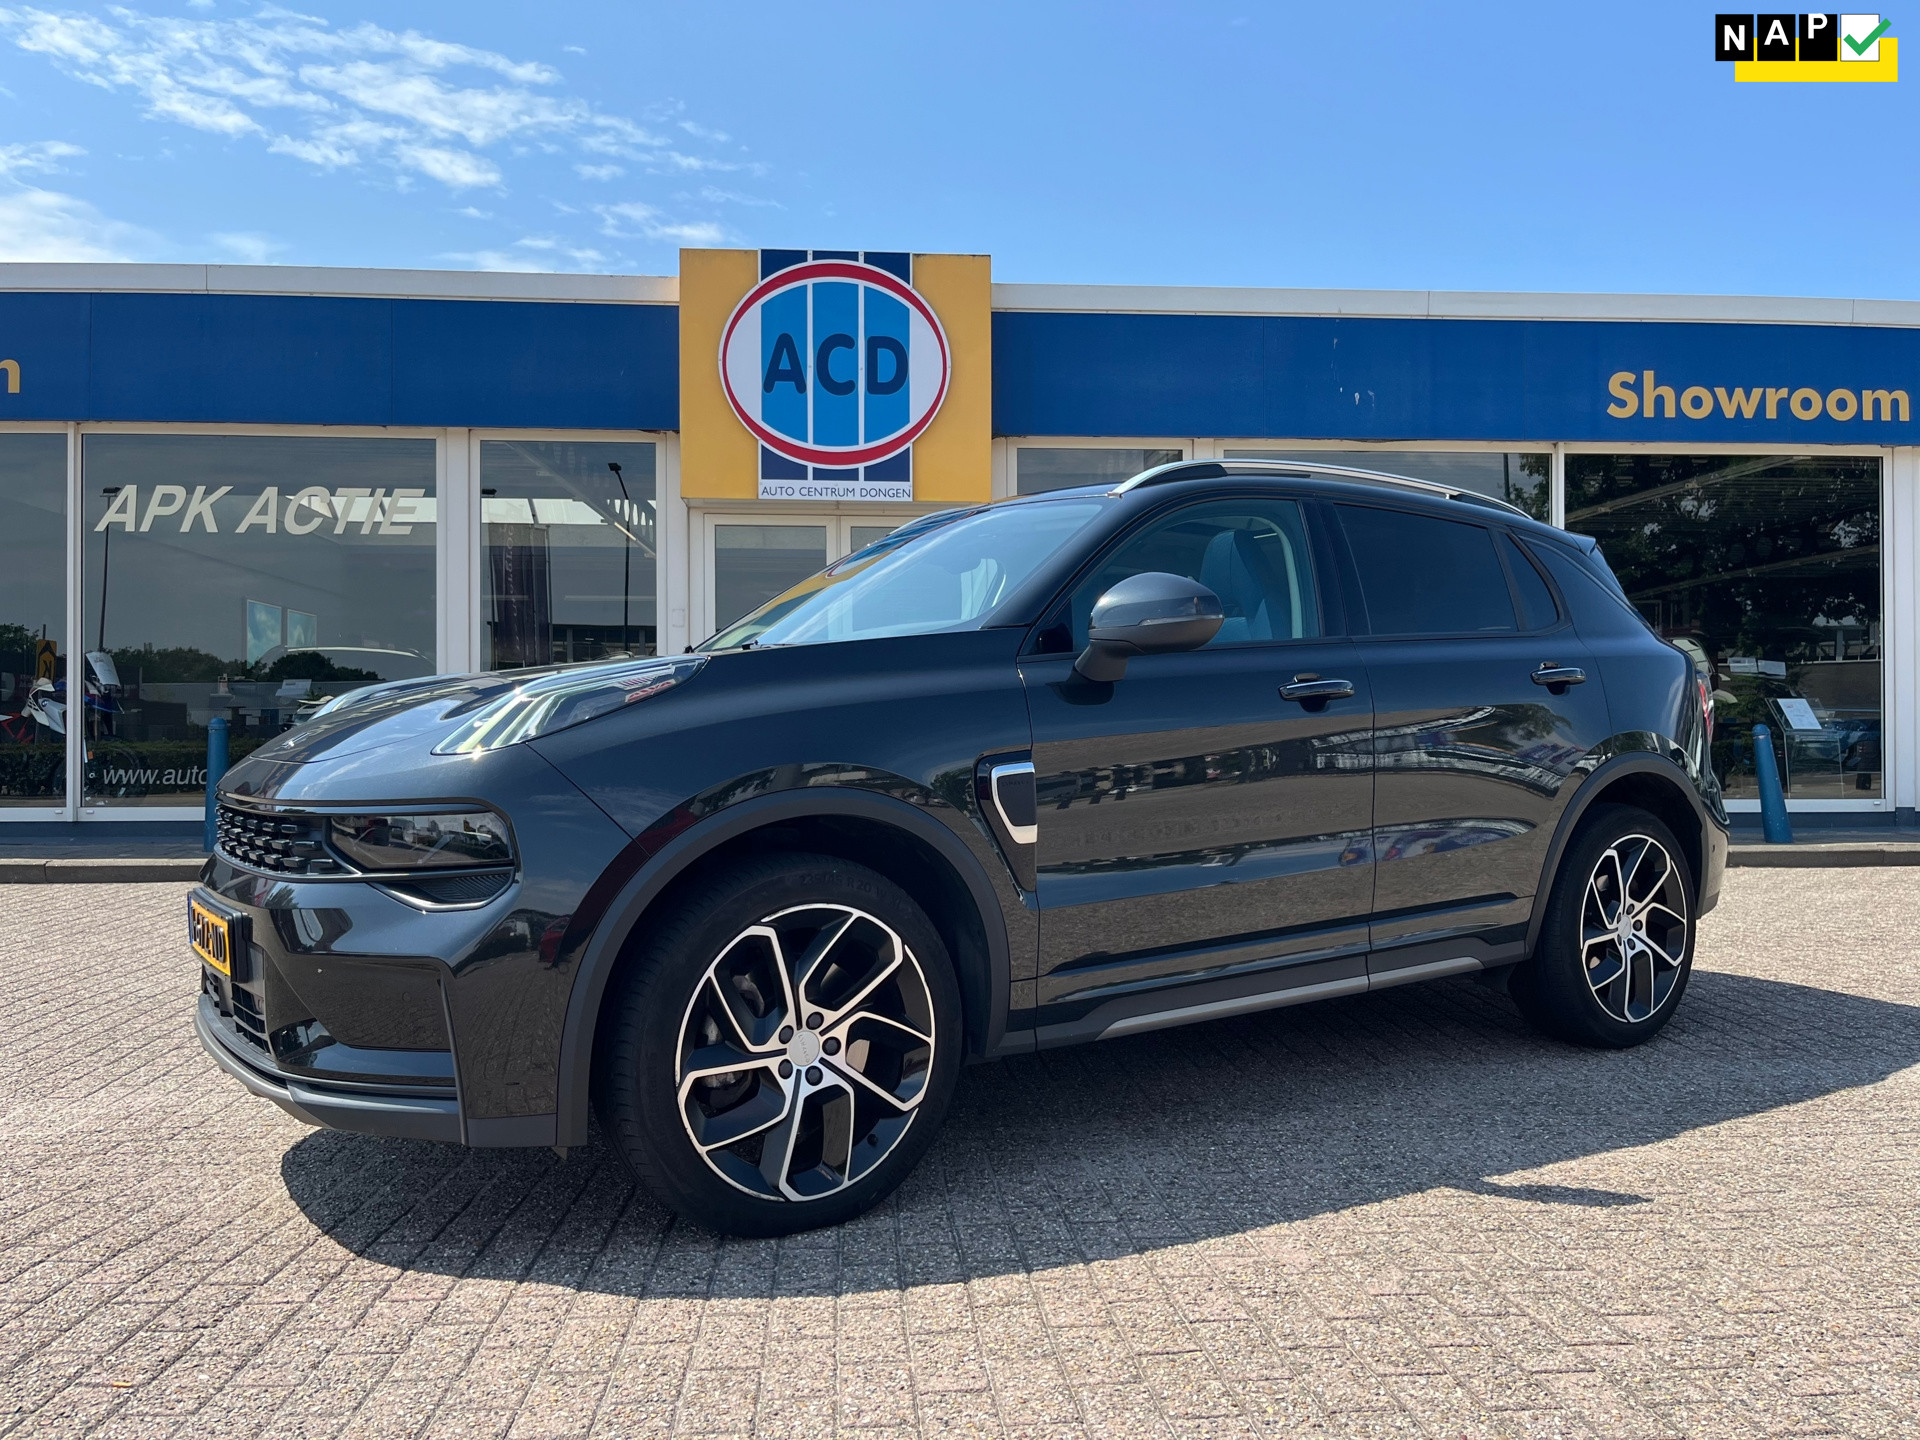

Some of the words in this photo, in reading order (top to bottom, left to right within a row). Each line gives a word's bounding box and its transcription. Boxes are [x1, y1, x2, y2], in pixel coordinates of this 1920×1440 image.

[763, 333, 909, 396] ACD
[1606, 370, 1910, 421] Showroom
[94, 485, 234, 532] APK
[235, 486, 426, 535] ACTIE
[761, 486, 795, 496] AUTO
[799, 487, 856, 497] CENTRUM
[860, 488, 911, 498] DONGEN
